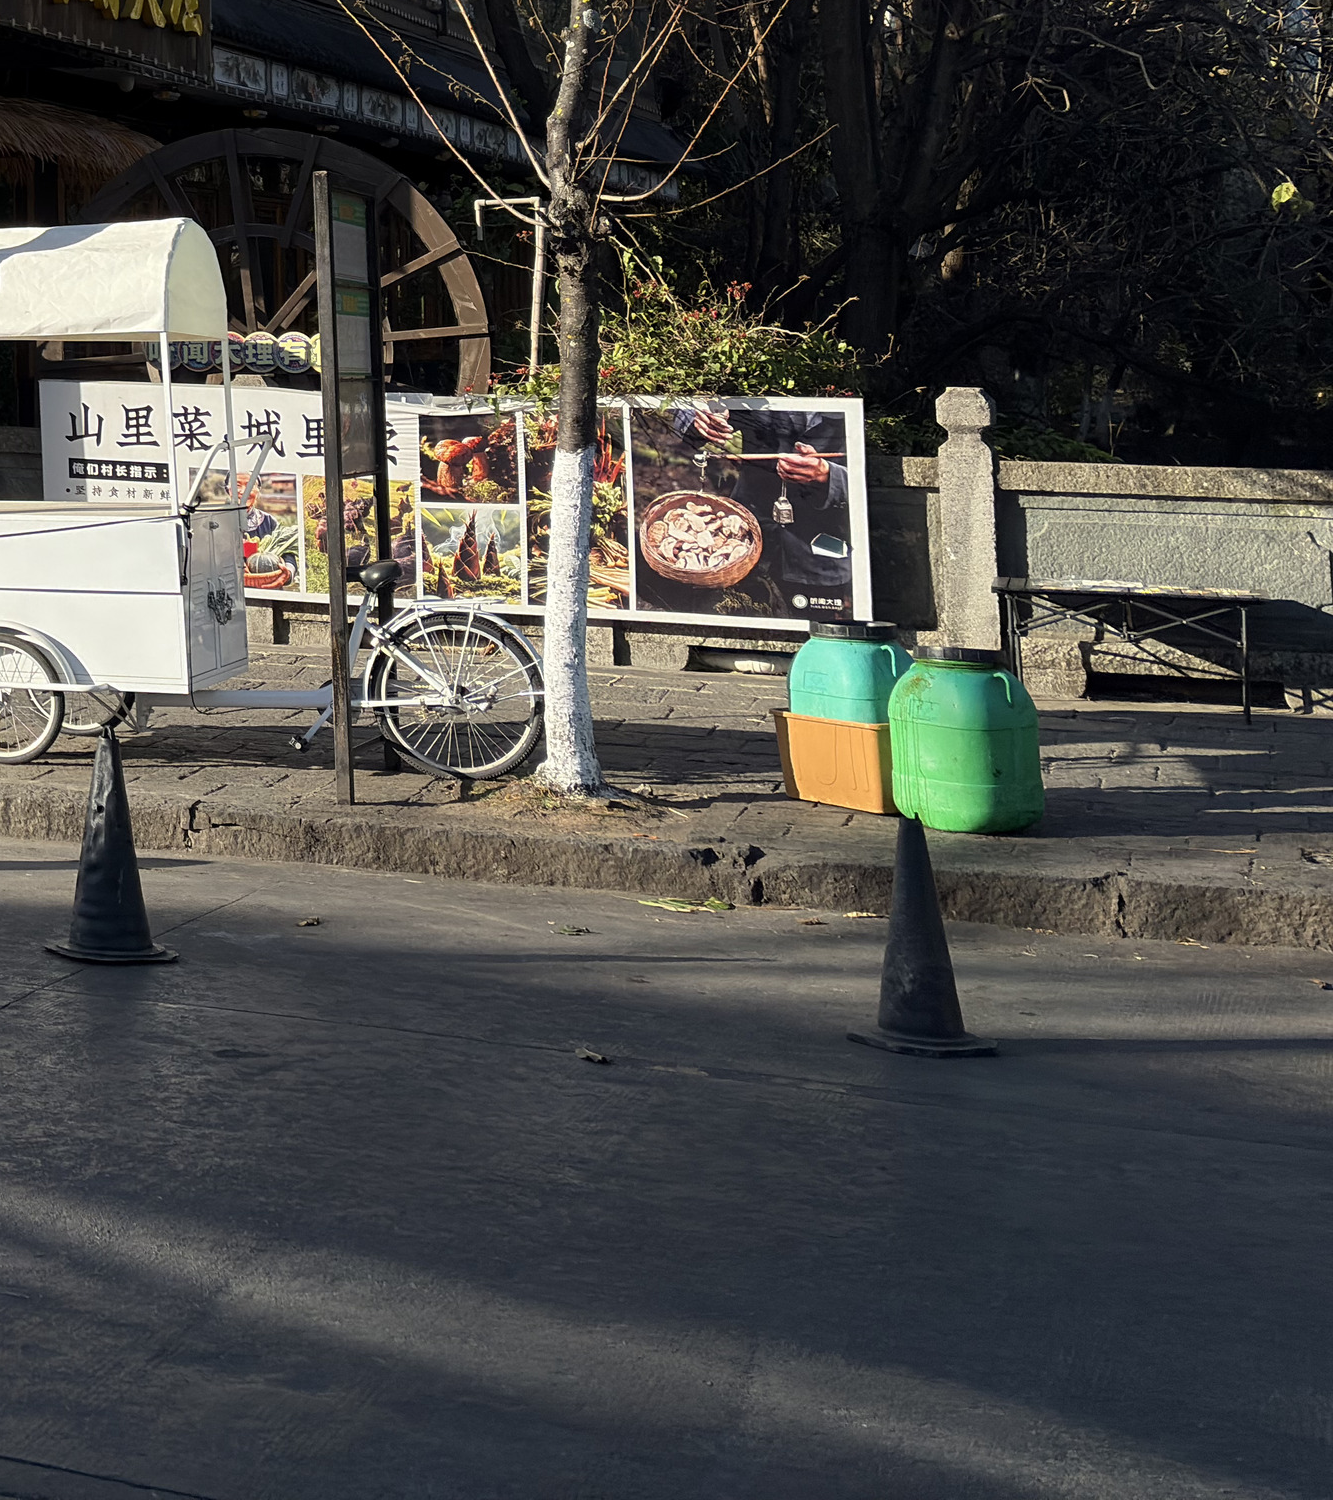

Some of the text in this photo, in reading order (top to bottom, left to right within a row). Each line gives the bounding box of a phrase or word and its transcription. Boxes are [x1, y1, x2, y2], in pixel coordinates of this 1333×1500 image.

[147, 340, 321, 368] 听闻大理有
